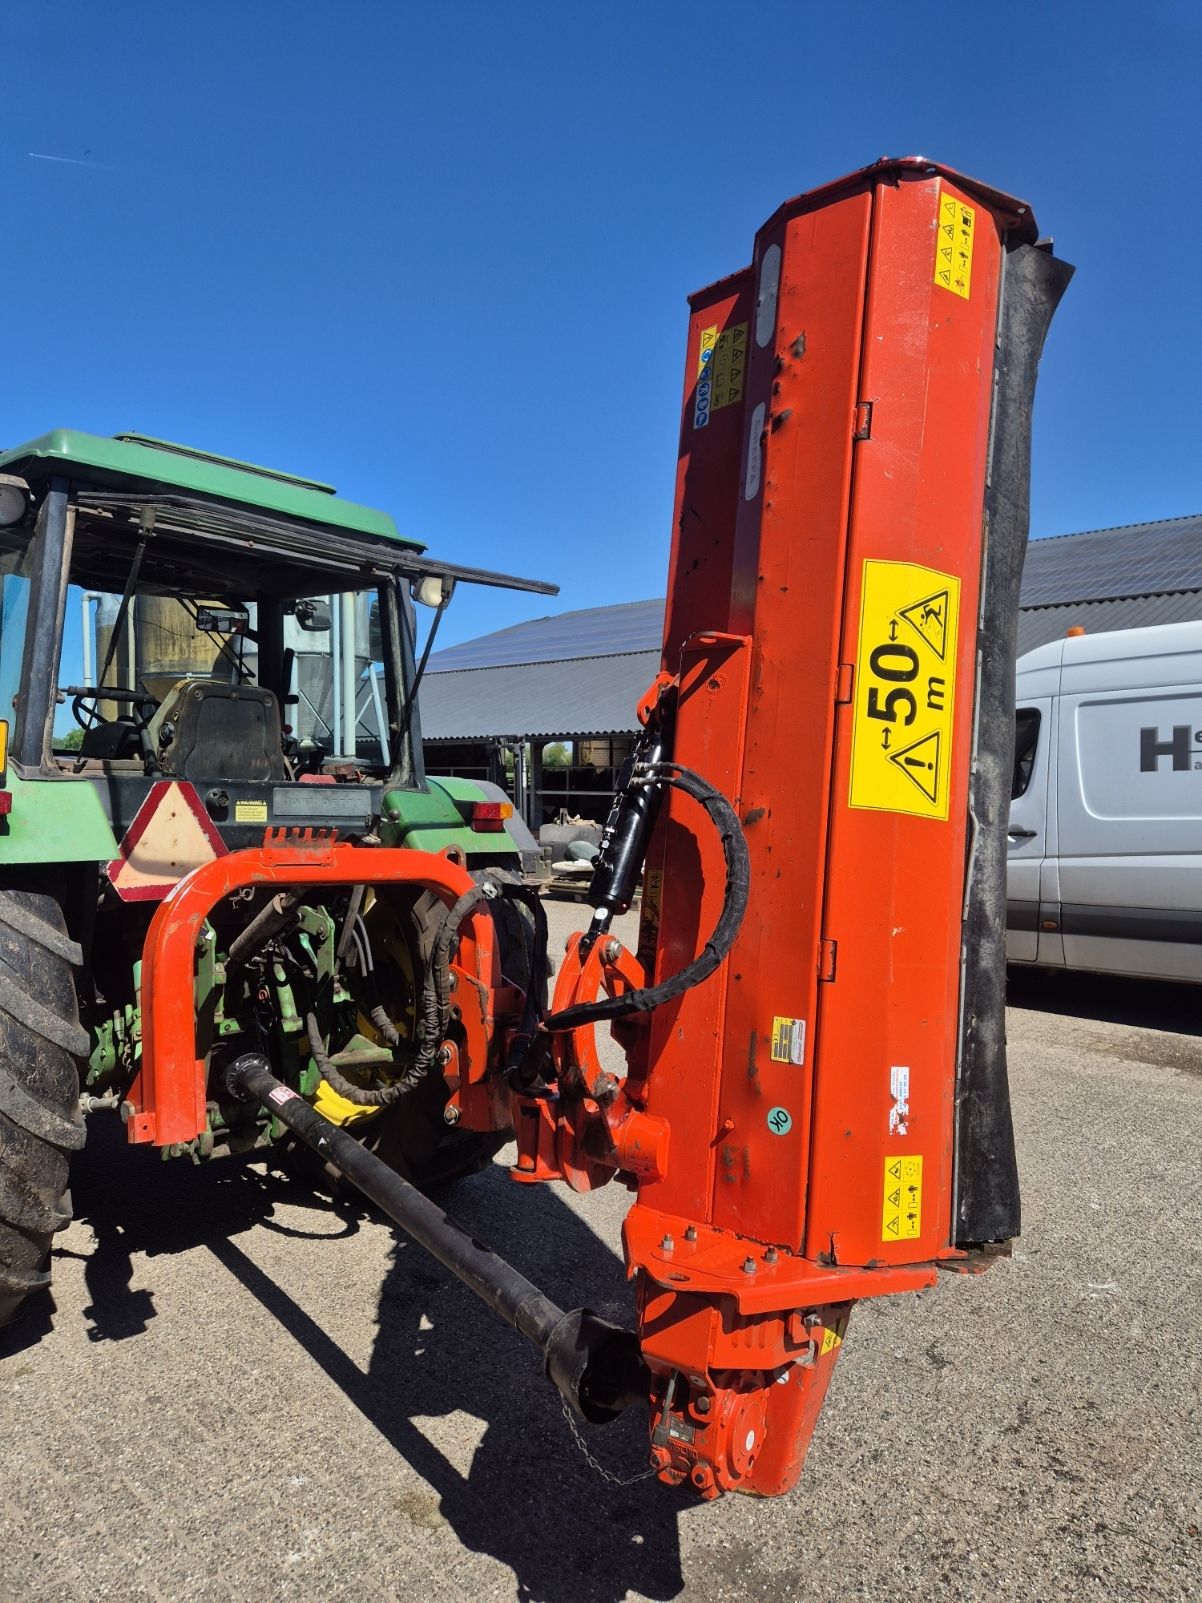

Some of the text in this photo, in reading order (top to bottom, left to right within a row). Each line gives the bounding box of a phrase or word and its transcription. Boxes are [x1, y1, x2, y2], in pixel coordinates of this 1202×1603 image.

[867, 643, 946, 726] 50 m
[769, 1110, 789, 1132] OK
